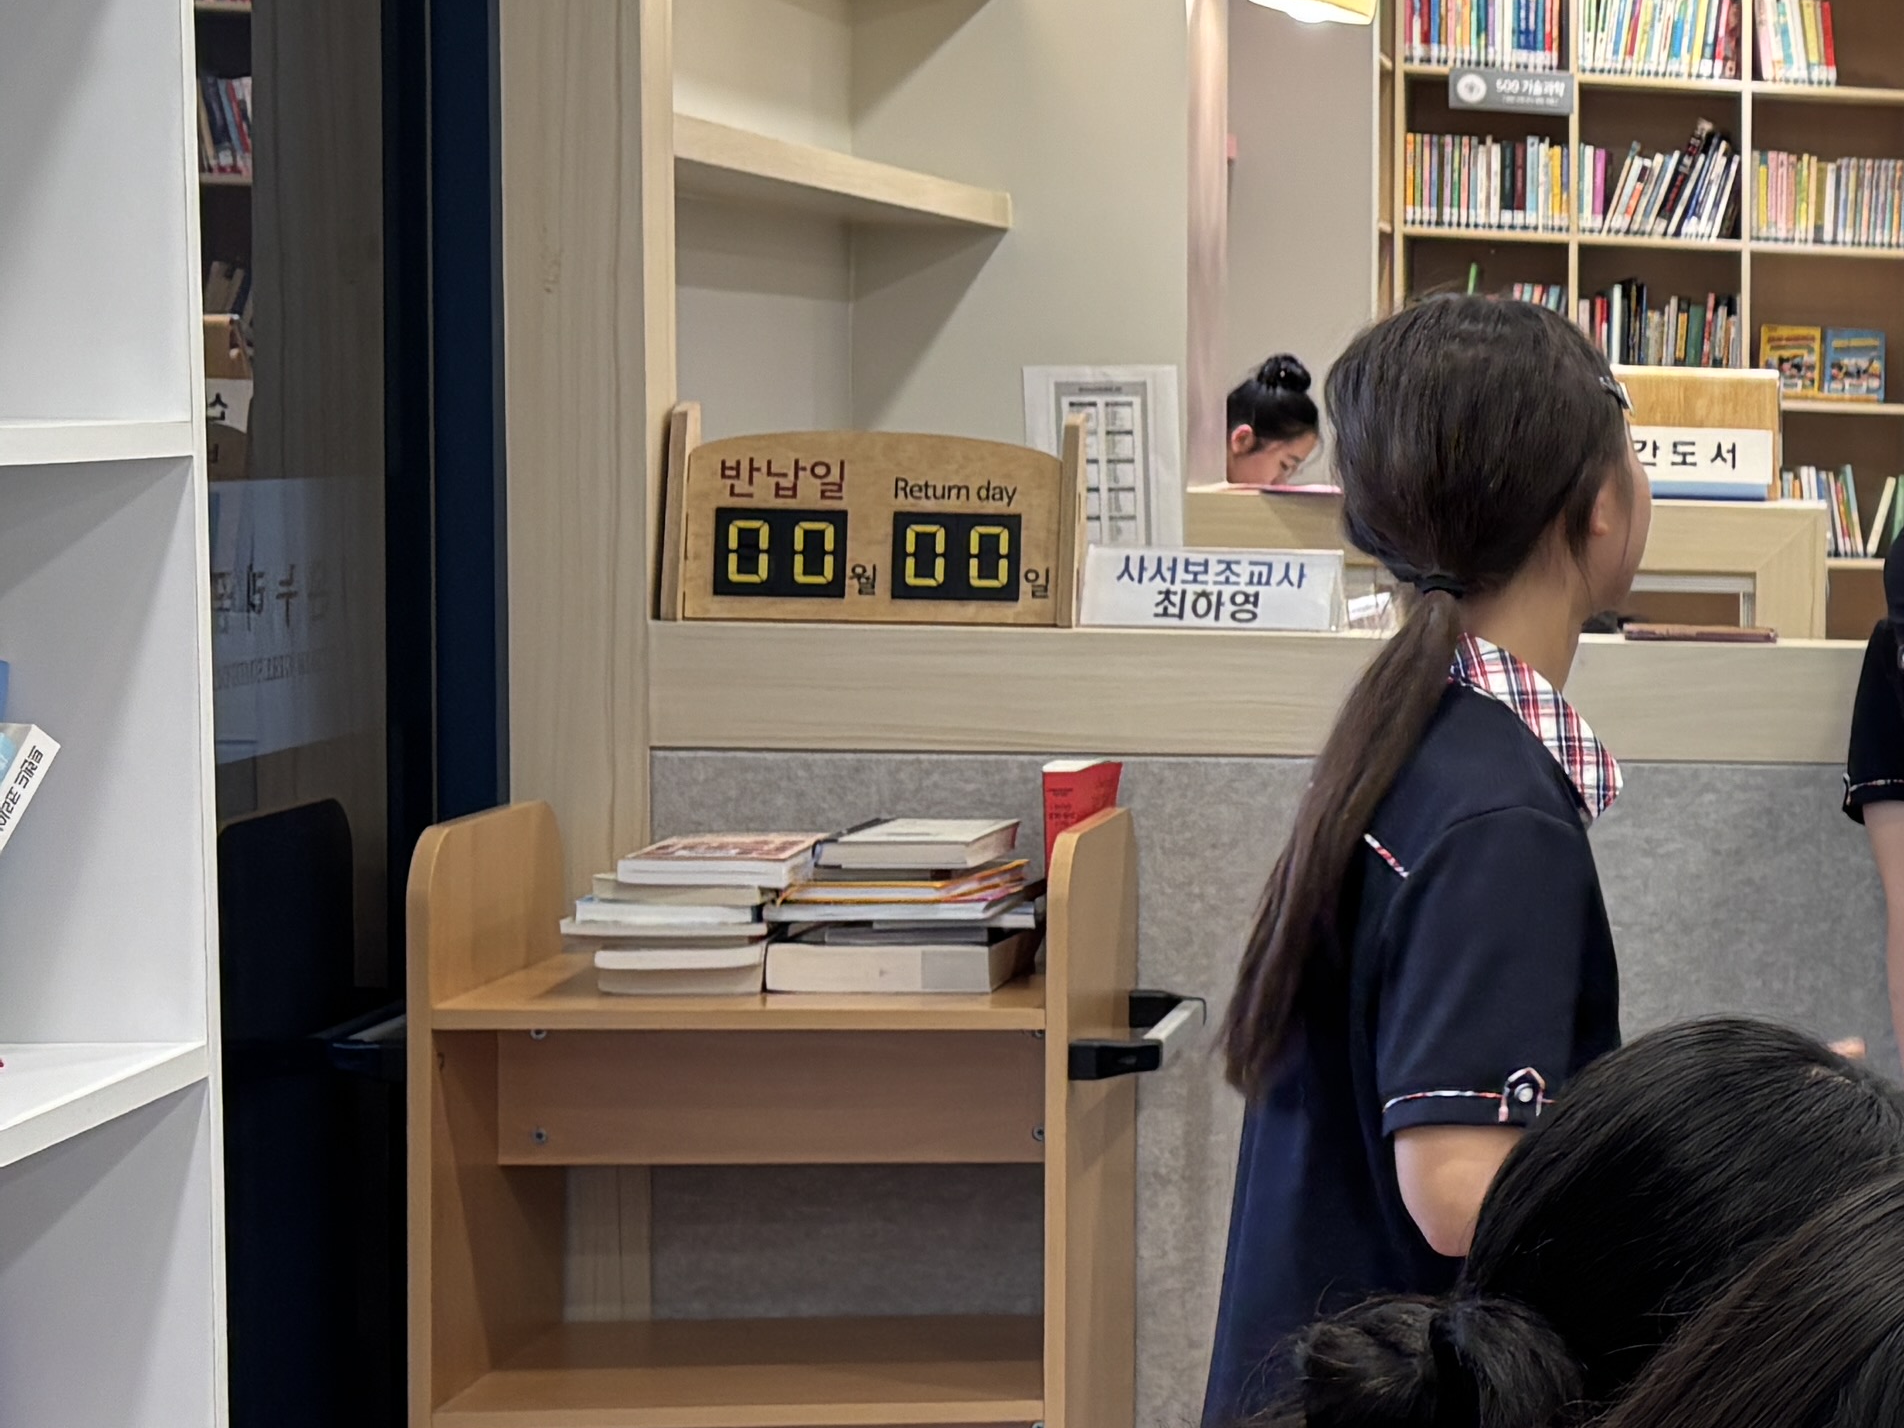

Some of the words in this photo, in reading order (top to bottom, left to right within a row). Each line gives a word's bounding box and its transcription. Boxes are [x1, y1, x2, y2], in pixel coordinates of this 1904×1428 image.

[721, 457, 845, 501] 반납일
[894, 477, 969, 501] Return
[977, 480, 1017, 507] day
[850, 564, 876, 595] 월
[1024, 568, 1049, 599] 일
[1116, 554, 1306, 589] 사서보조교사
[1153, 588, 1260, 623] 최하영
[14, 745, 44, 789] 트렌드
